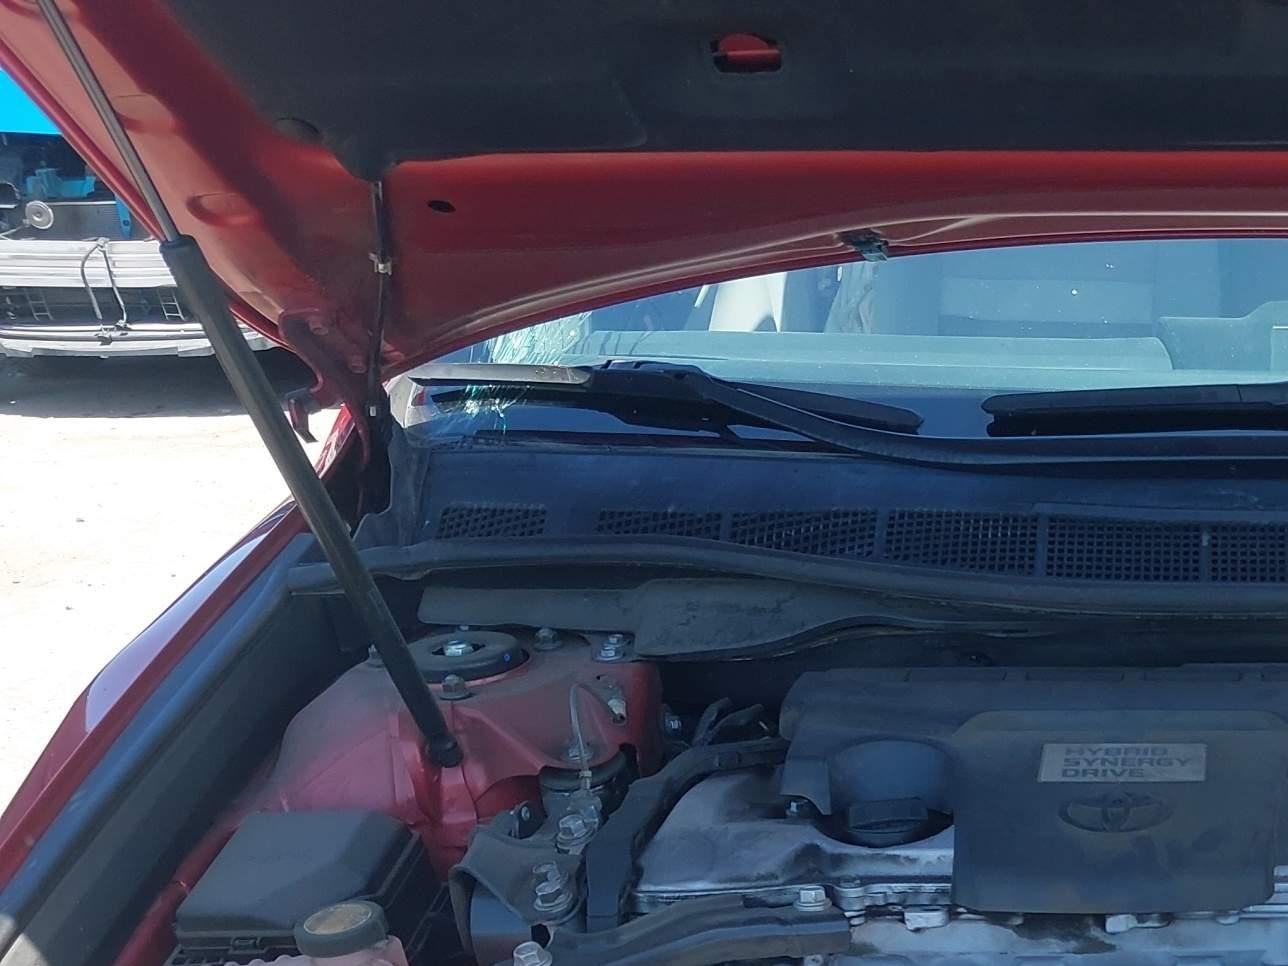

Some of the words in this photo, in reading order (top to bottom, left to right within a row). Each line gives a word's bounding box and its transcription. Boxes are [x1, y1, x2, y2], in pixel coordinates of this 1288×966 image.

[1065, 746, 1169, 757] HYBRID
[1063, 757, 1193, 767] SYNERGY
[1061, 768, 1146, 778] DRIVE
